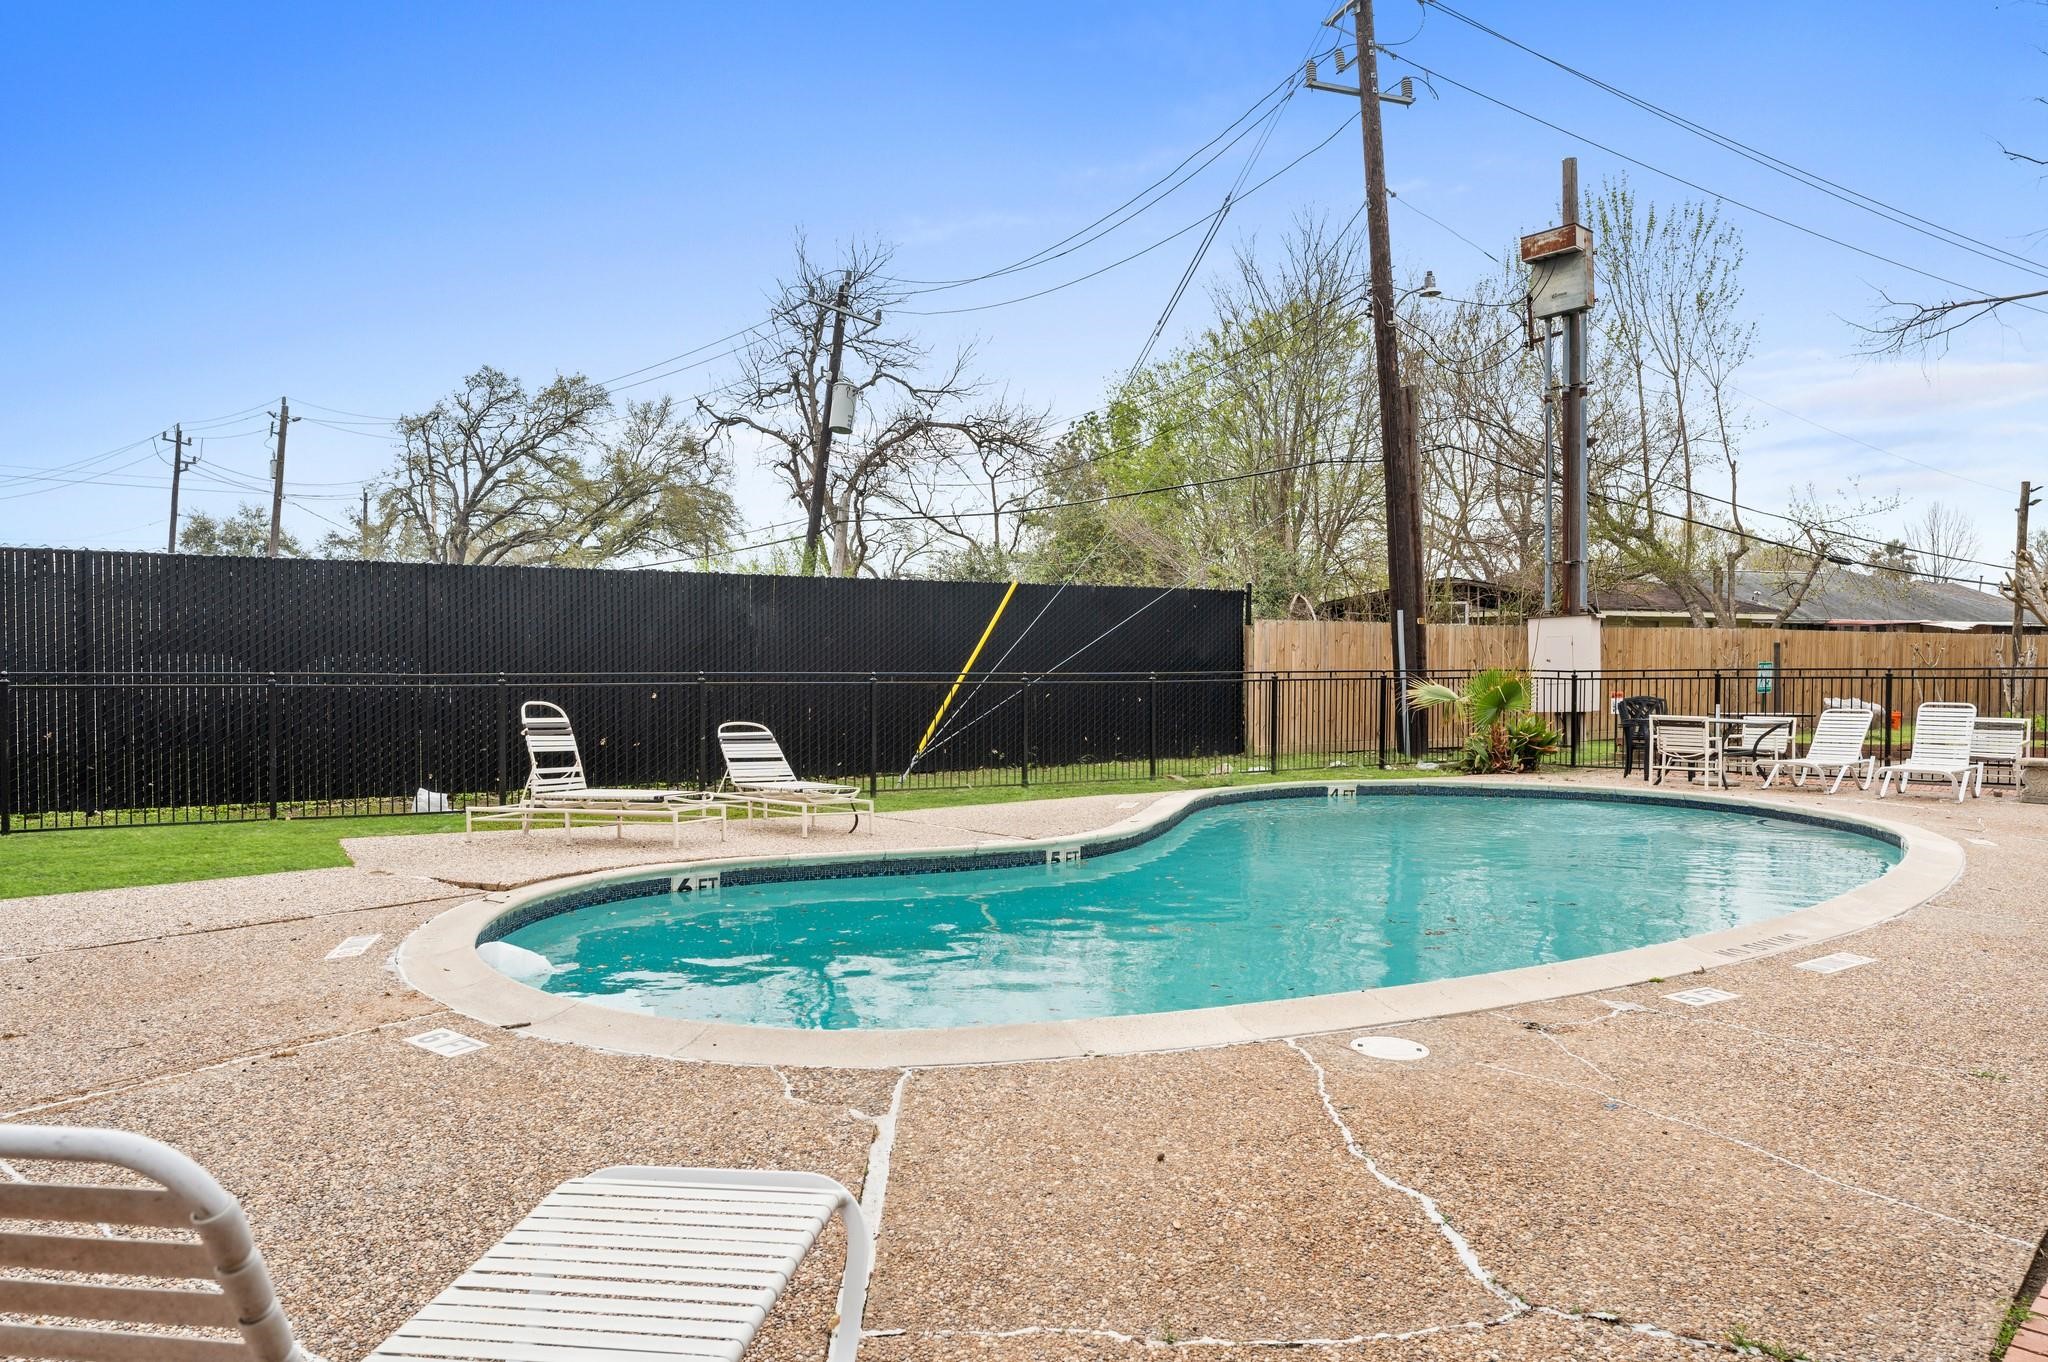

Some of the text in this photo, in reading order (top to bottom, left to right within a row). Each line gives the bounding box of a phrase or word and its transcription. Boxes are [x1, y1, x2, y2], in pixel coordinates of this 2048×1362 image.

[1343, 789, 1356, 798] FT
[1051, 850, 1079, 864] 5 FT
[677, 876, 719, 892] 6 FT
